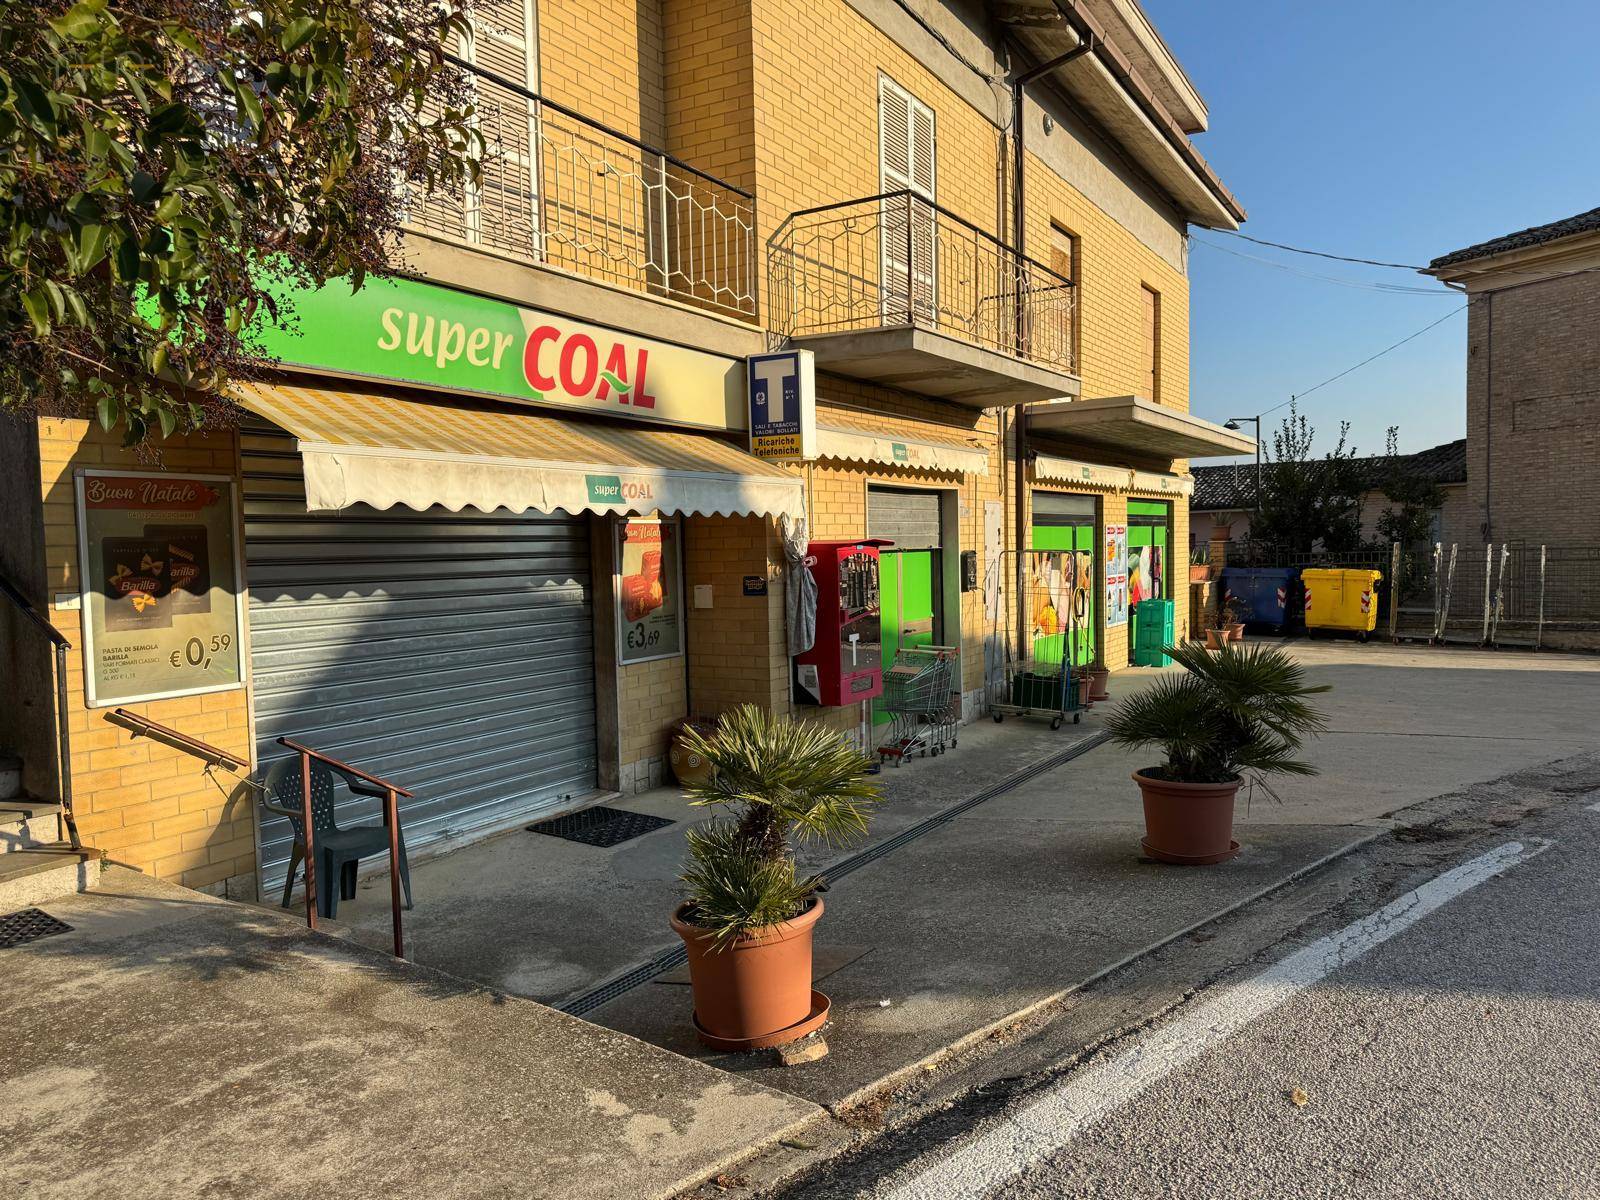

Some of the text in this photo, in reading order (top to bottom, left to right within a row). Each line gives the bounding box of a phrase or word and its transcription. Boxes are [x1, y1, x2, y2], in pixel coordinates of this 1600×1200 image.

[377, 307, 656, 409] super COAL
[754, 357, 795, 423] T
[758, 436, 795, 447] Ricariche
[754, 446, 799, 456] Telefoniche
[87, 480, 198, 504] Buon Natale
[594, 482, 653, 499] super COAL
[121, 580, 155, 591] Barilla
[102, 647, 123, 655] PASTA
